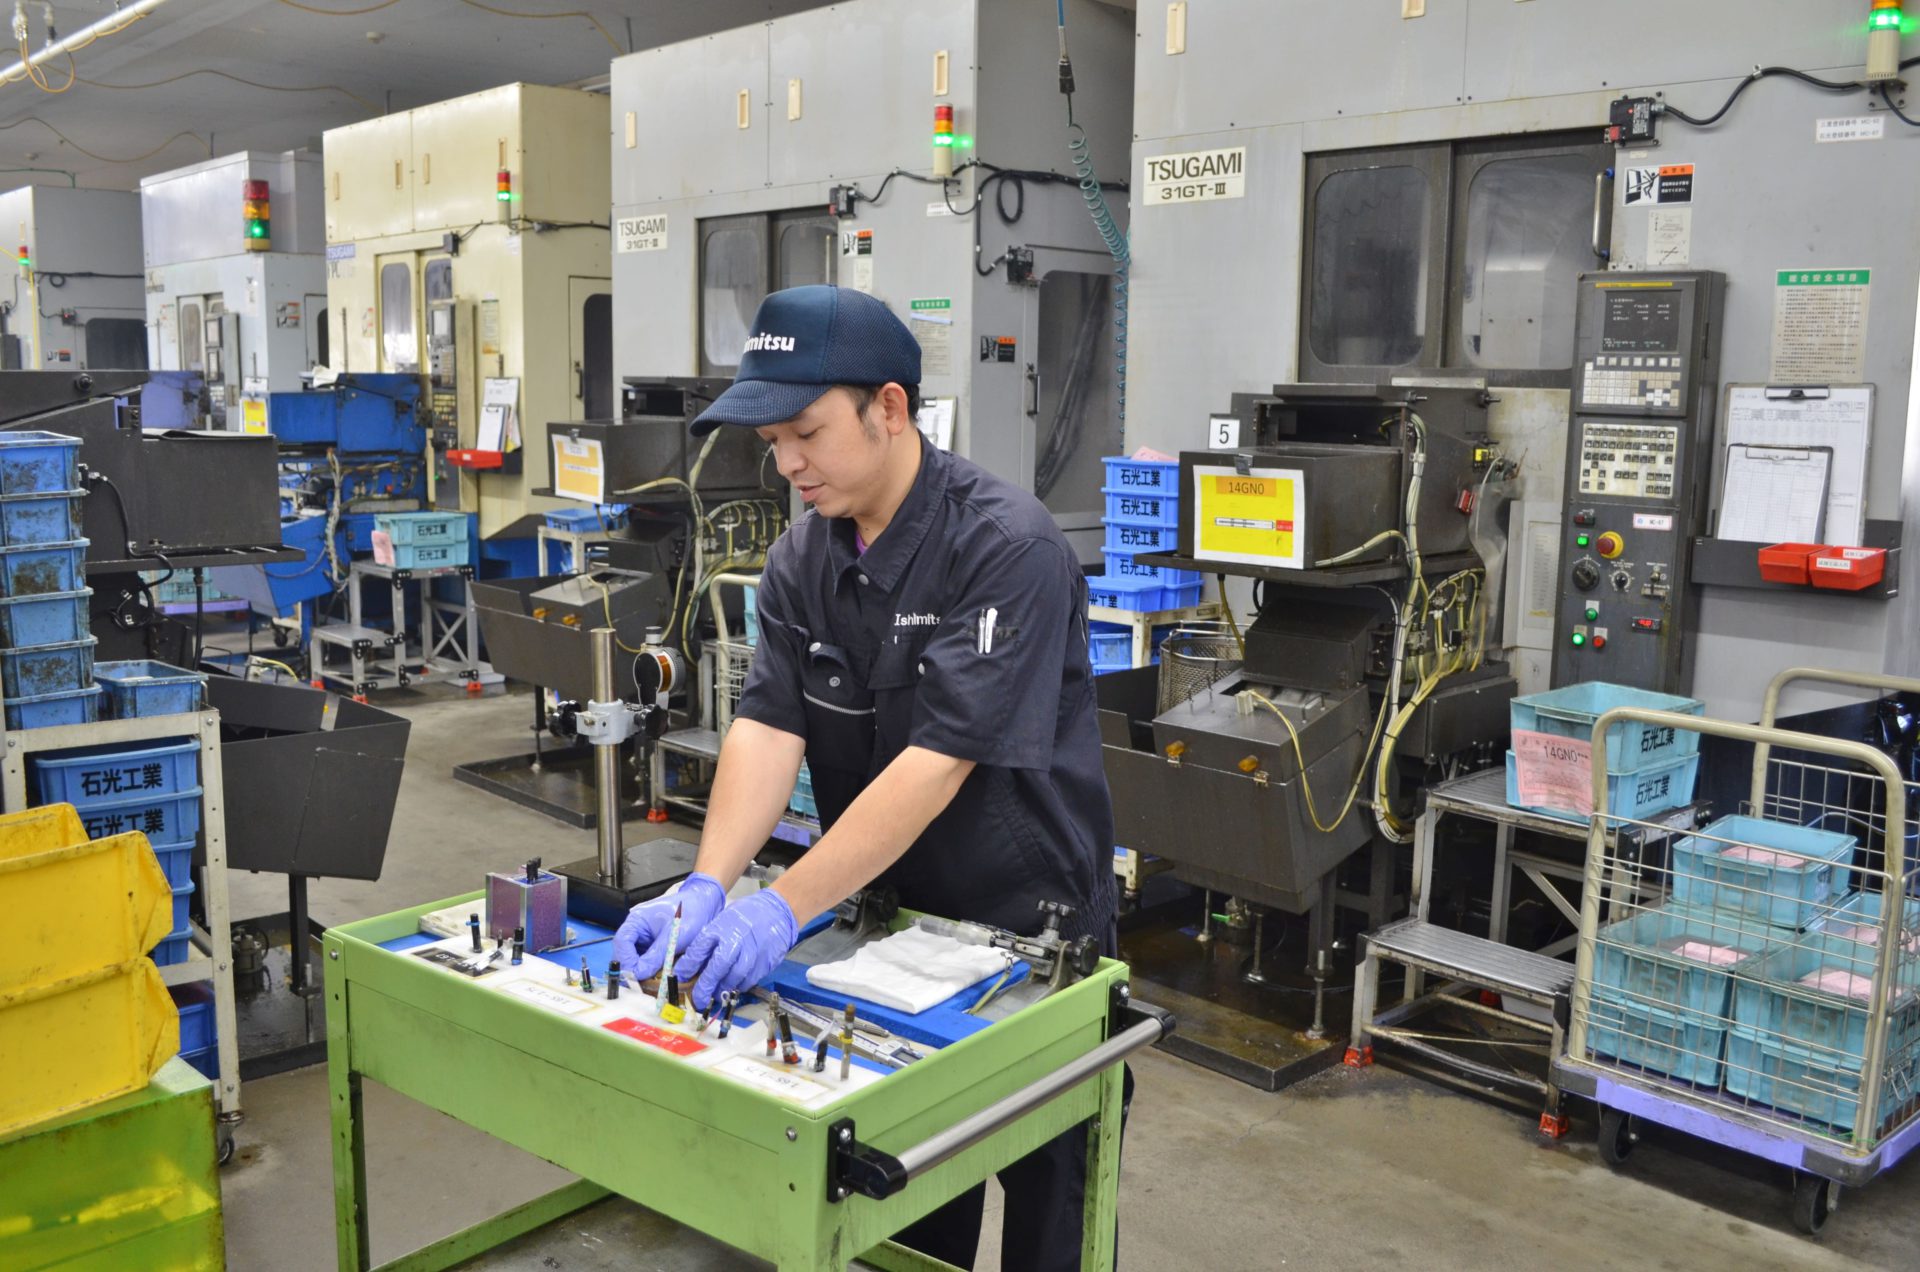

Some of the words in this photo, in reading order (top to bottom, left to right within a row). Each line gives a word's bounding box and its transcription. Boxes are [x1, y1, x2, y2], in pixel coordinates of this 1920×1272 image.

[1147, 152, 1243, 181] TSUGAMI
[618, 217, 666, 237] TSUGAMI
[1218, 423, 1230, 444] 5
[1120, 468, 1161, 487] 石光工業
[1120, 498, 1160, 517] 石光工業
[417, 524, 447, 536] 石光工業
[1120, 528, 1160, 547] 石光工業
[418, 548, 448, 561] 石光工業
[1641, 726, 1675, 754] 石光工業
[81, 763, 163, 798] 石光工業
[1635, 774, 1671, 806] 石光工業
